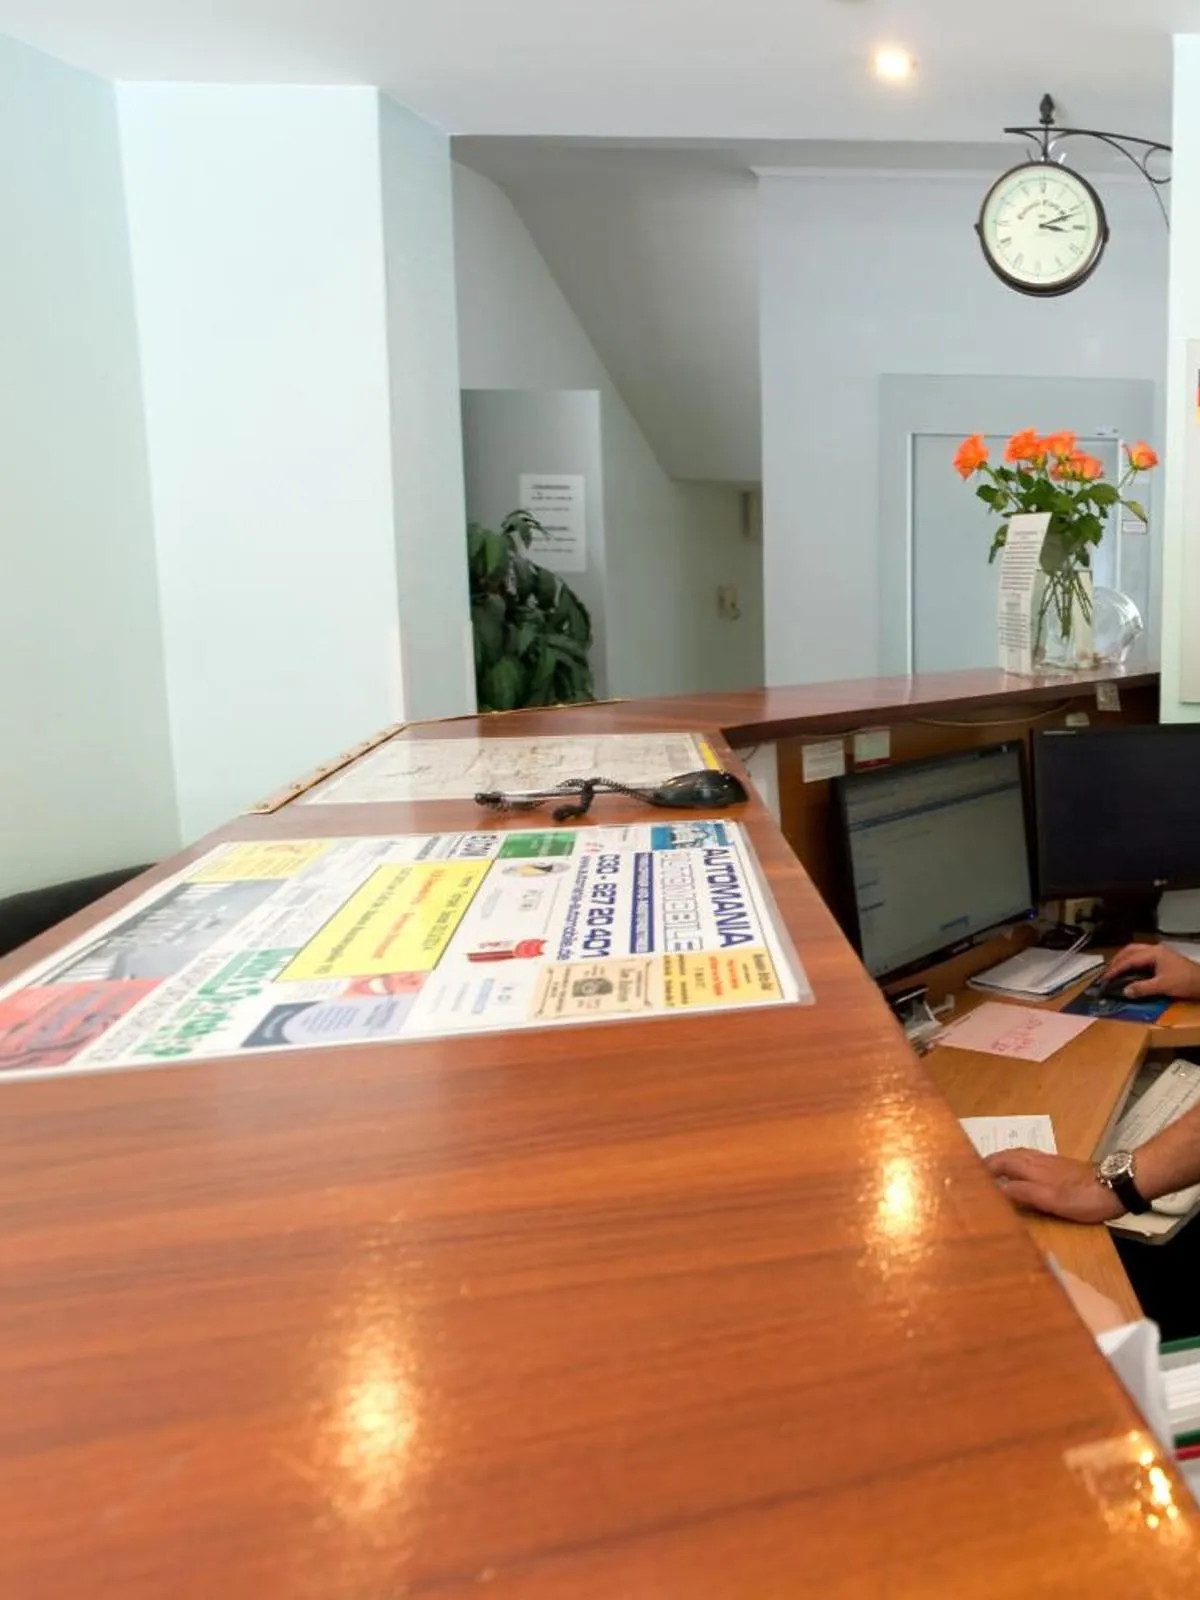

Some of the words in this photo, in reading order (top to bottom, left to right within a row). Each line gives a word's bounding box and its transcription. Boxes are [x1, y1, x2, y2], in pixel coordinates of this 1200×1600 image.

[703, 849, 754, 947] AUTOMANIA
[586, 907, 615, 926] 20
[580, 928, 612, 959] 401
